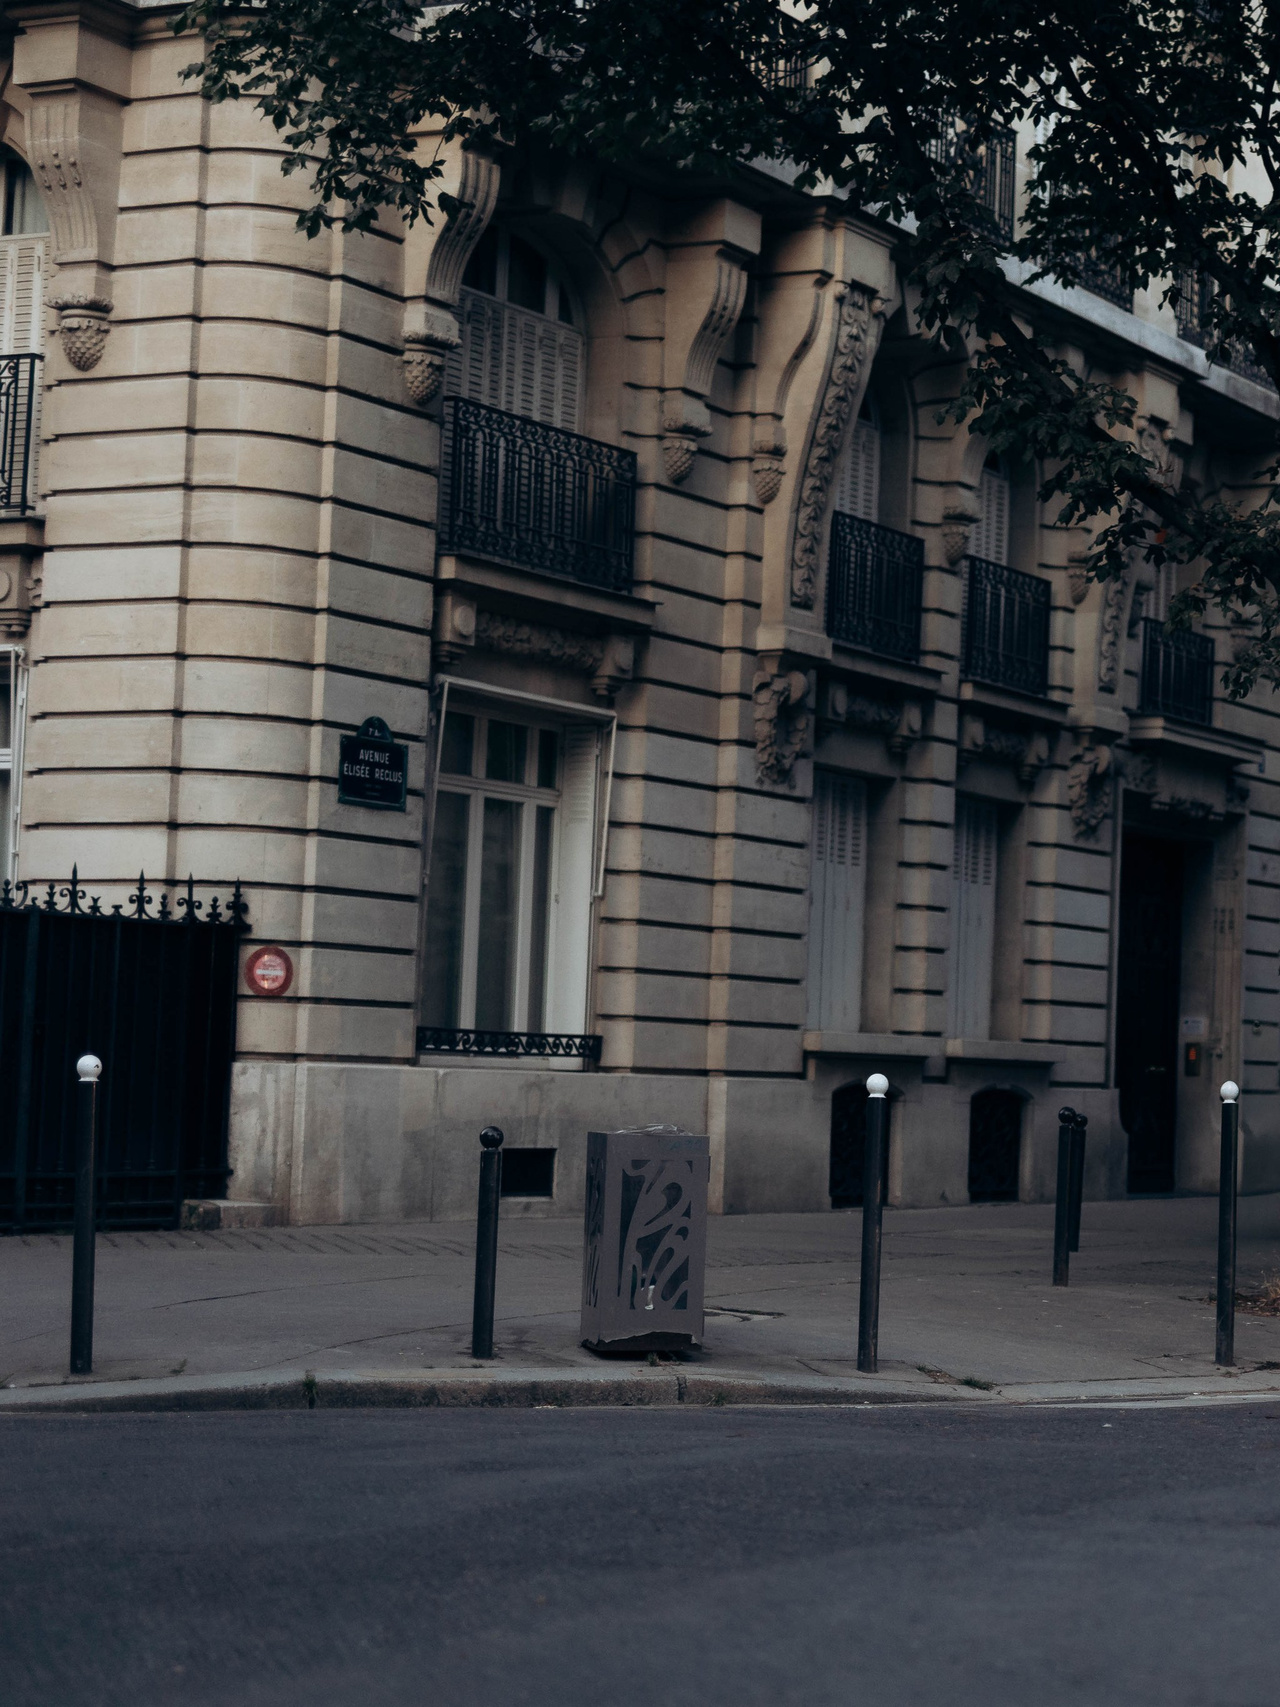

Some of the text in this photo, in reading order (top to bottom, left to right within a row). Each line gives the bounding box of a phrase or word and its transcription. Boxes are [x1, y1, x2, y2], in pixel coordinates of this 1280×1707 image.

[359, 749, 390, 764] AVENUE
[343, 761, 402, 783] ÉLISÉE RECLUS
